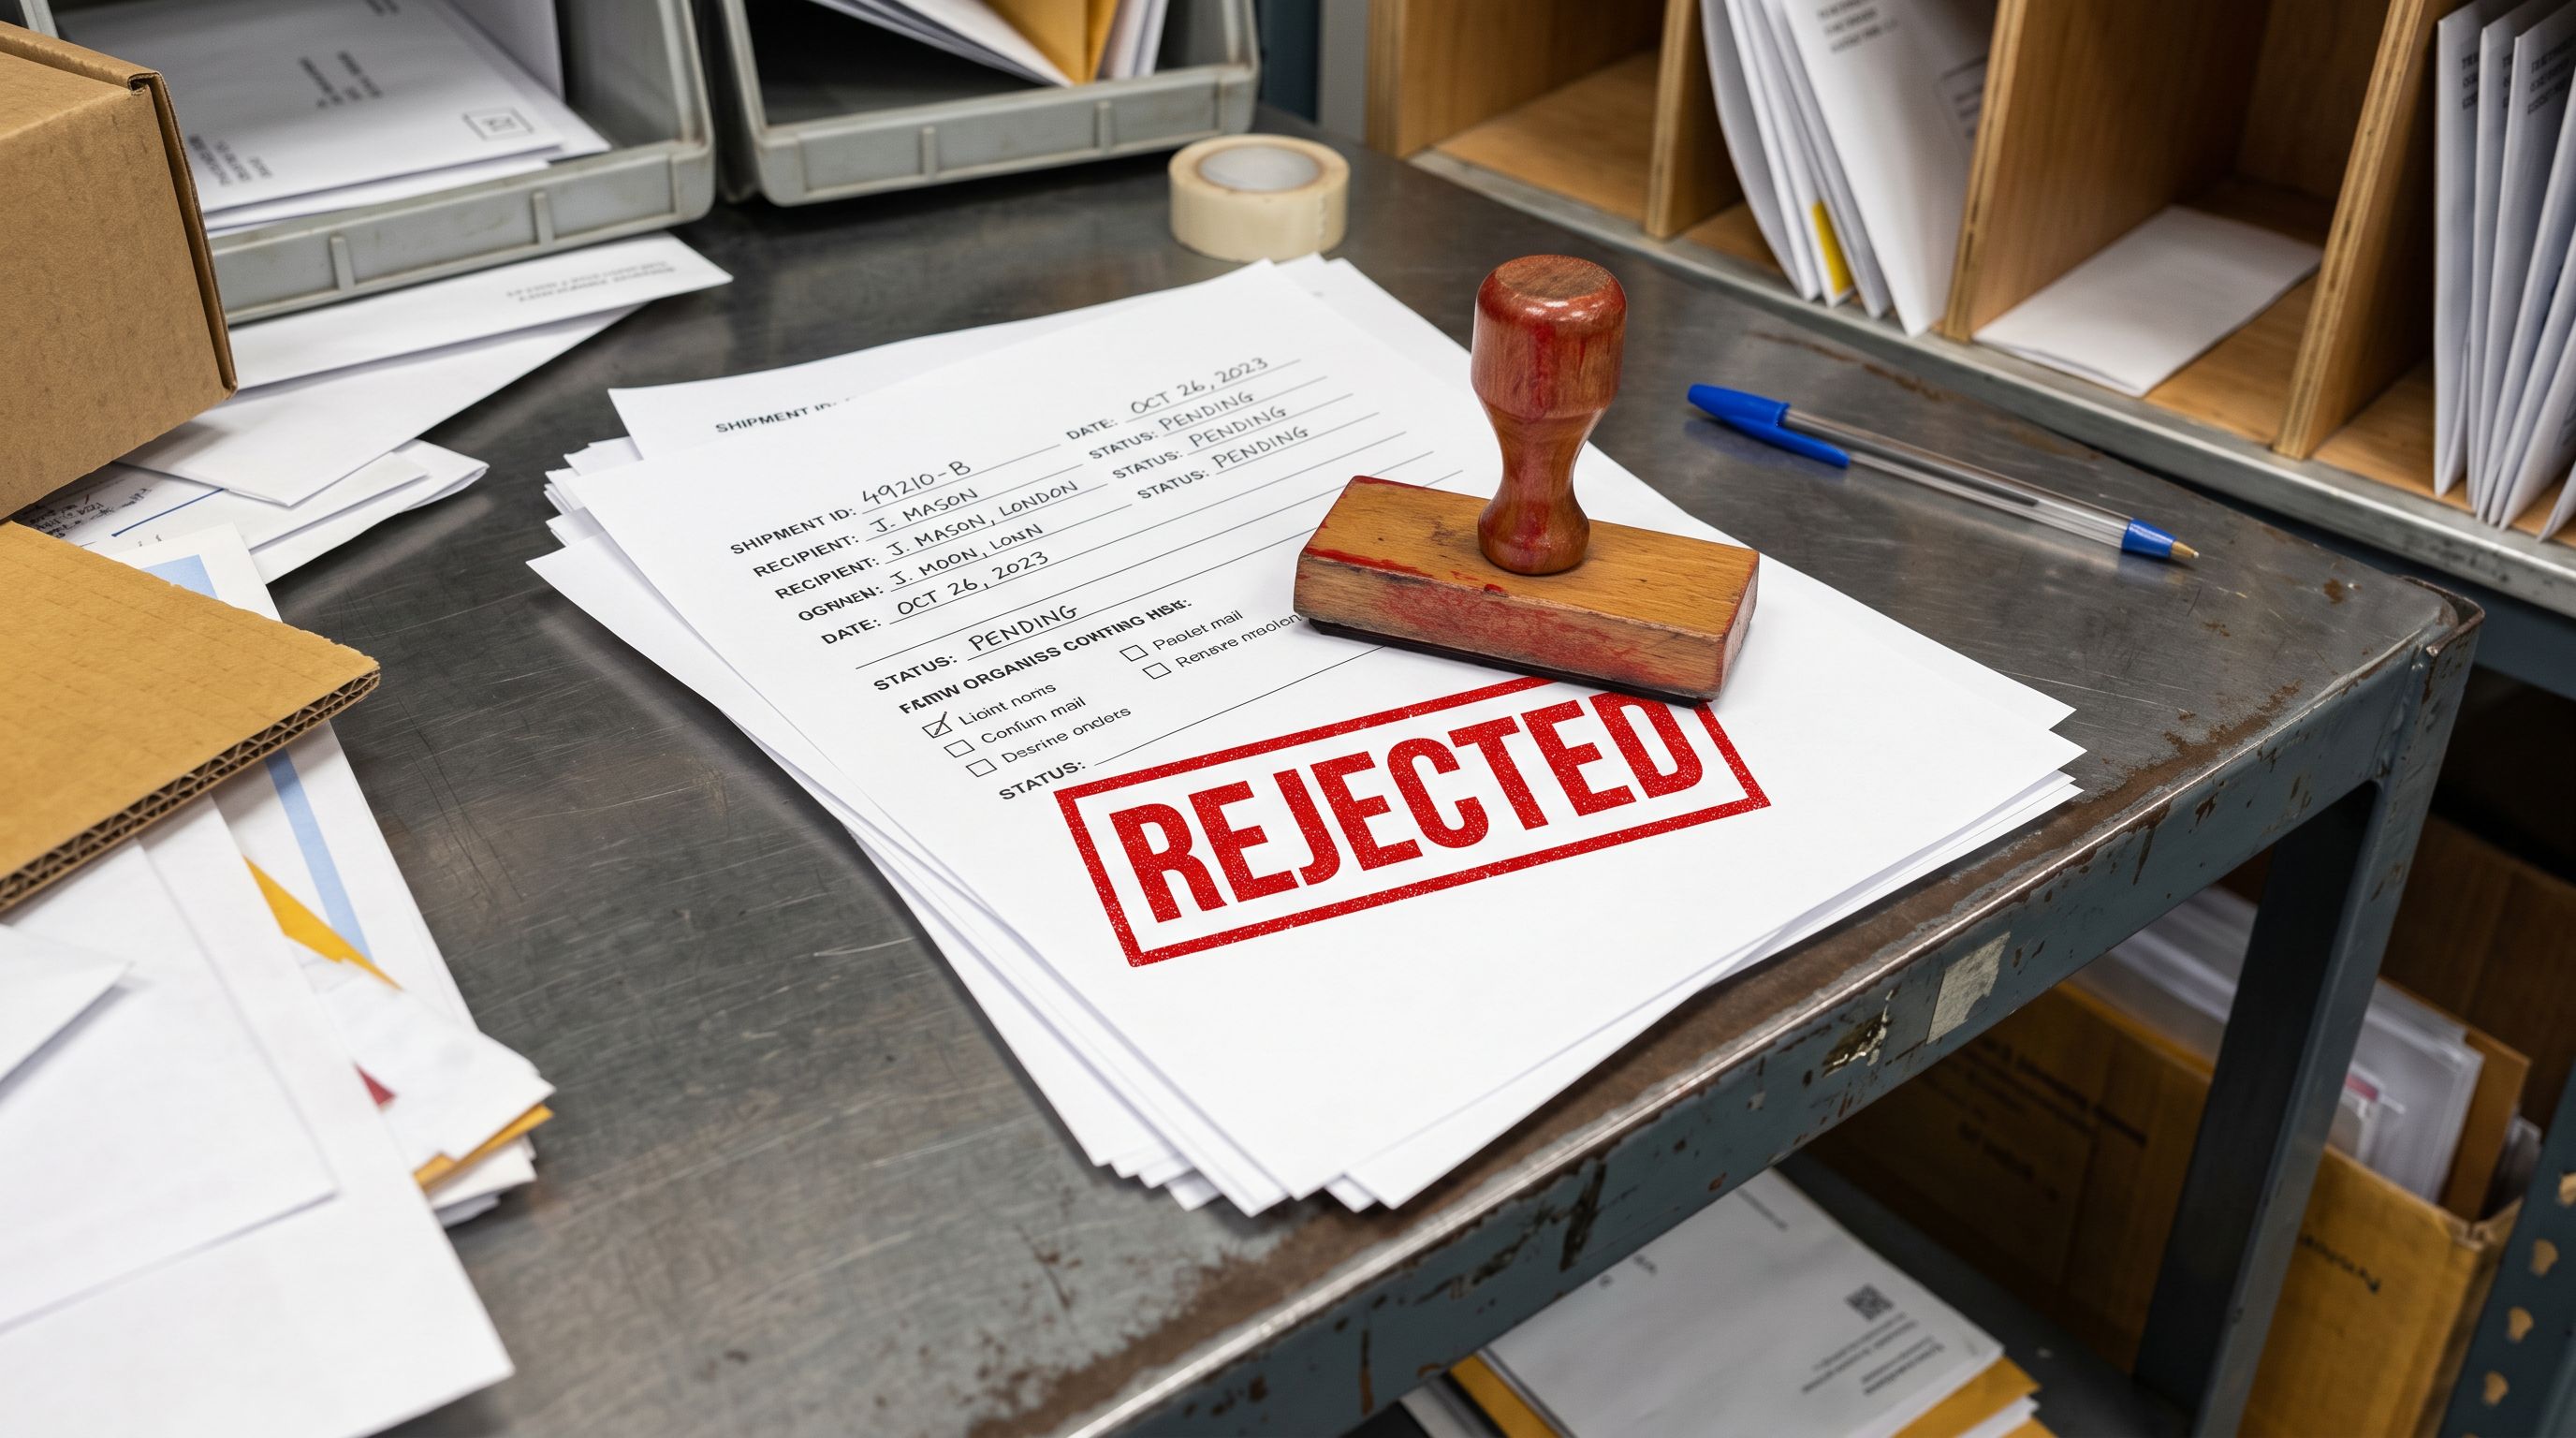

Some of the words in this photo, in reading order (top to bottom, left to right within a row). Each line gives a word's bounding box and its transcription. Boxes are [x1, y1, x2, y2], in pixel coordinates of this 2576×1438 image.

[715, 406, 809, 433] SHIPMENT
[1066, 418, 1118, 440] DATE:
[1130, 391, 1171, 414] OCT
[1214, 358, 1268, 384] 2023
[1089, 430, 1159, 460] STATUS:
[1159, 391, 1254, 431] PENDING
[1112, 450, 1182, 479] STATUS:
[1189, 405, 1287, 448] PENDING
[1137, 469, 1209, 499] STATUS:
[1211, 426, 1310, 468] PENDING
[730, 515, 827, 554] SHIPMENT
[828, 507, 856, 522] ID:
[862, 461, 972, 504] 49210-B
[753, 536, 859, 578] RECIPIENT:
[869, 517, 896, 533] J.
[902, 488, 978, 521] MASON
[774, 557, 880, 599] RECIPIENT:
[886, 541, 911, 556] J.
[915, 514, 996, 547] MASON,
[999, 480, 1078, 516] LONDON
[821, 618, 882, 646] DATE:
[897, 591, 937, 615] OCT
[991, 551, 1048, 580] 2023
[890, 571, 913, 585] J.
[918, 548, 988, 576] MOON,
[873, 655, 958, 691] STATUS:
[968, 605, 1078, 652] PENDING
[1210, 609, 1244, 630] mail
[963, 647, 1061, 690] ORGANISS
[1050, 697, 1086, 719] mail
[999, 760, 1086, 800] STATUS:
[1109, 693, 1704, 923] REJECTED
